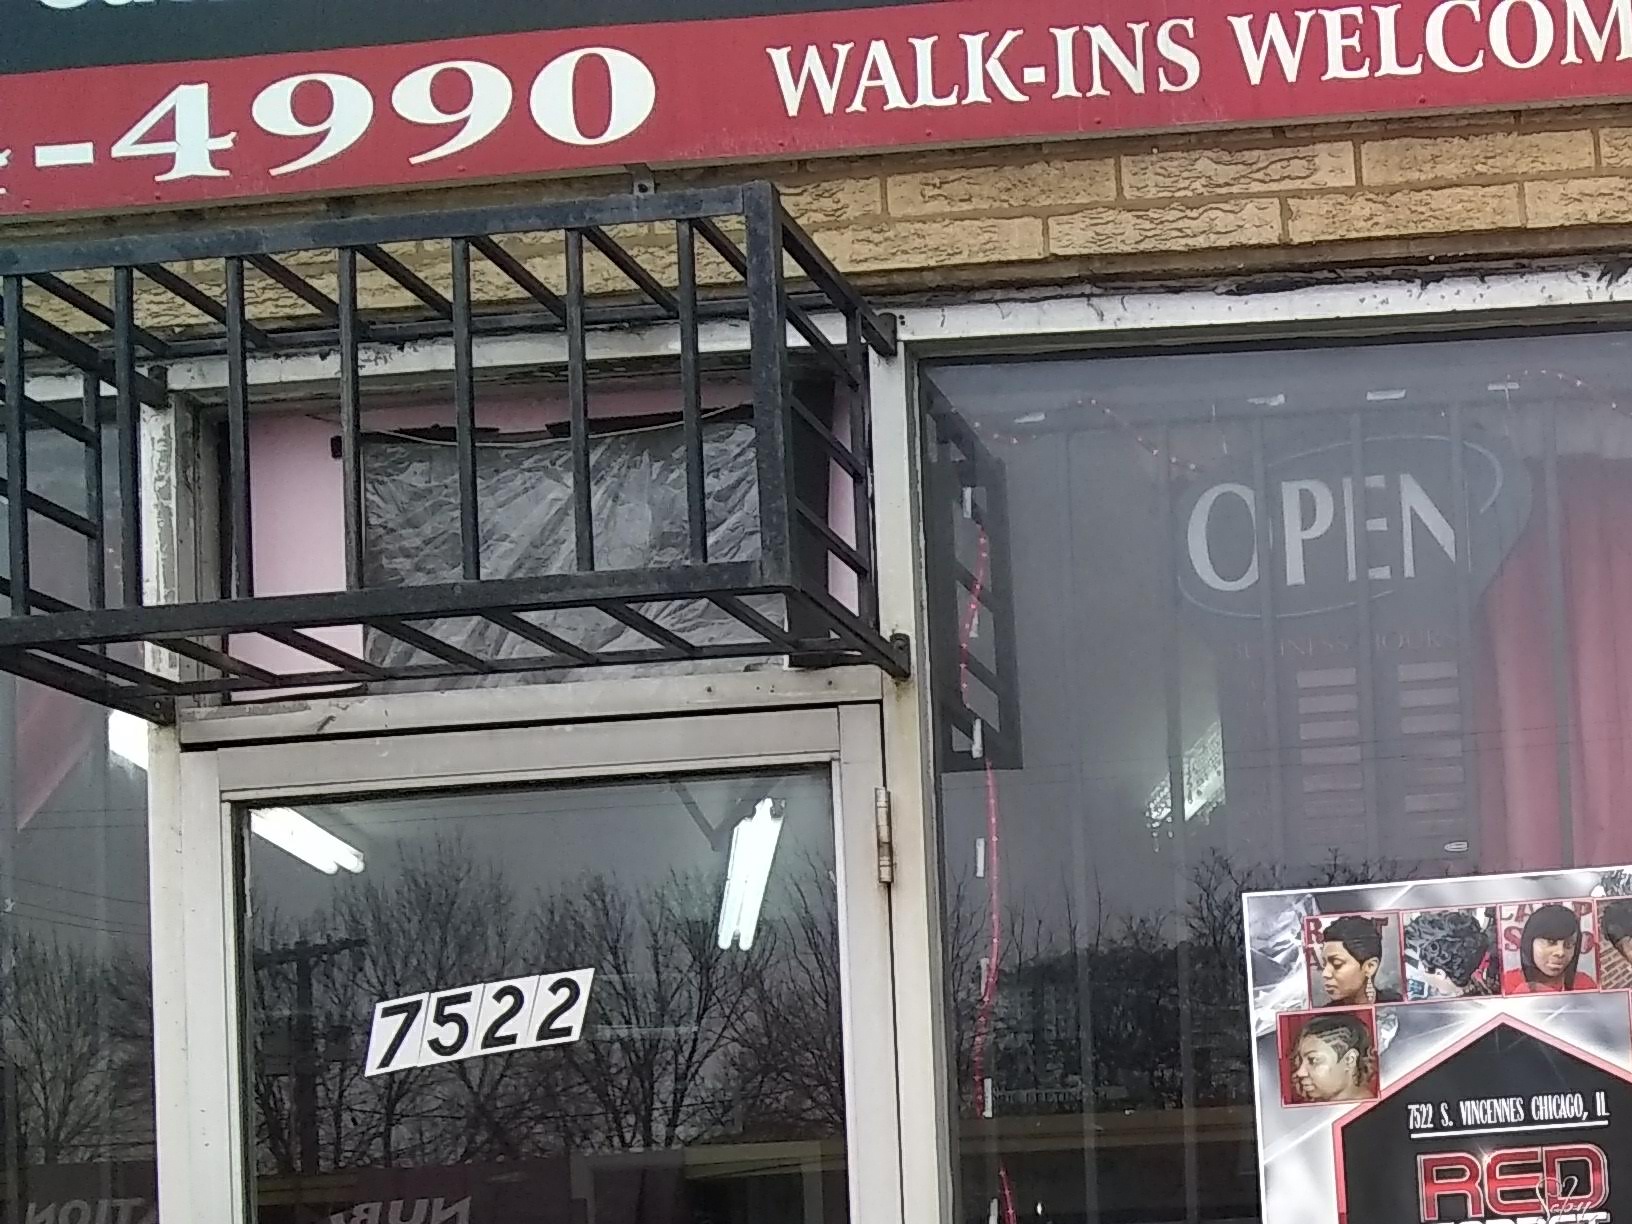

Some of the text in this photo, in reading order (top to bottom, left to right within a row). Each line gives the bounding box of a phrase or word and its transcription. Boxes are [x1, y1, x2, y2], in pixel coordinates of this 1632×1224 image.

[766, 19, 1201, 118] WALK-INS
[0, 46, 657, 195] -4990
[1187, 473, 1472, 592] OPEN
[376, 977, 581, 1070] 7522
[1407, 1091, 1610, 1130] 7522 S. VINCENNES CHICAGO, IL
[1416, 1142, 1610, 1222] RED
